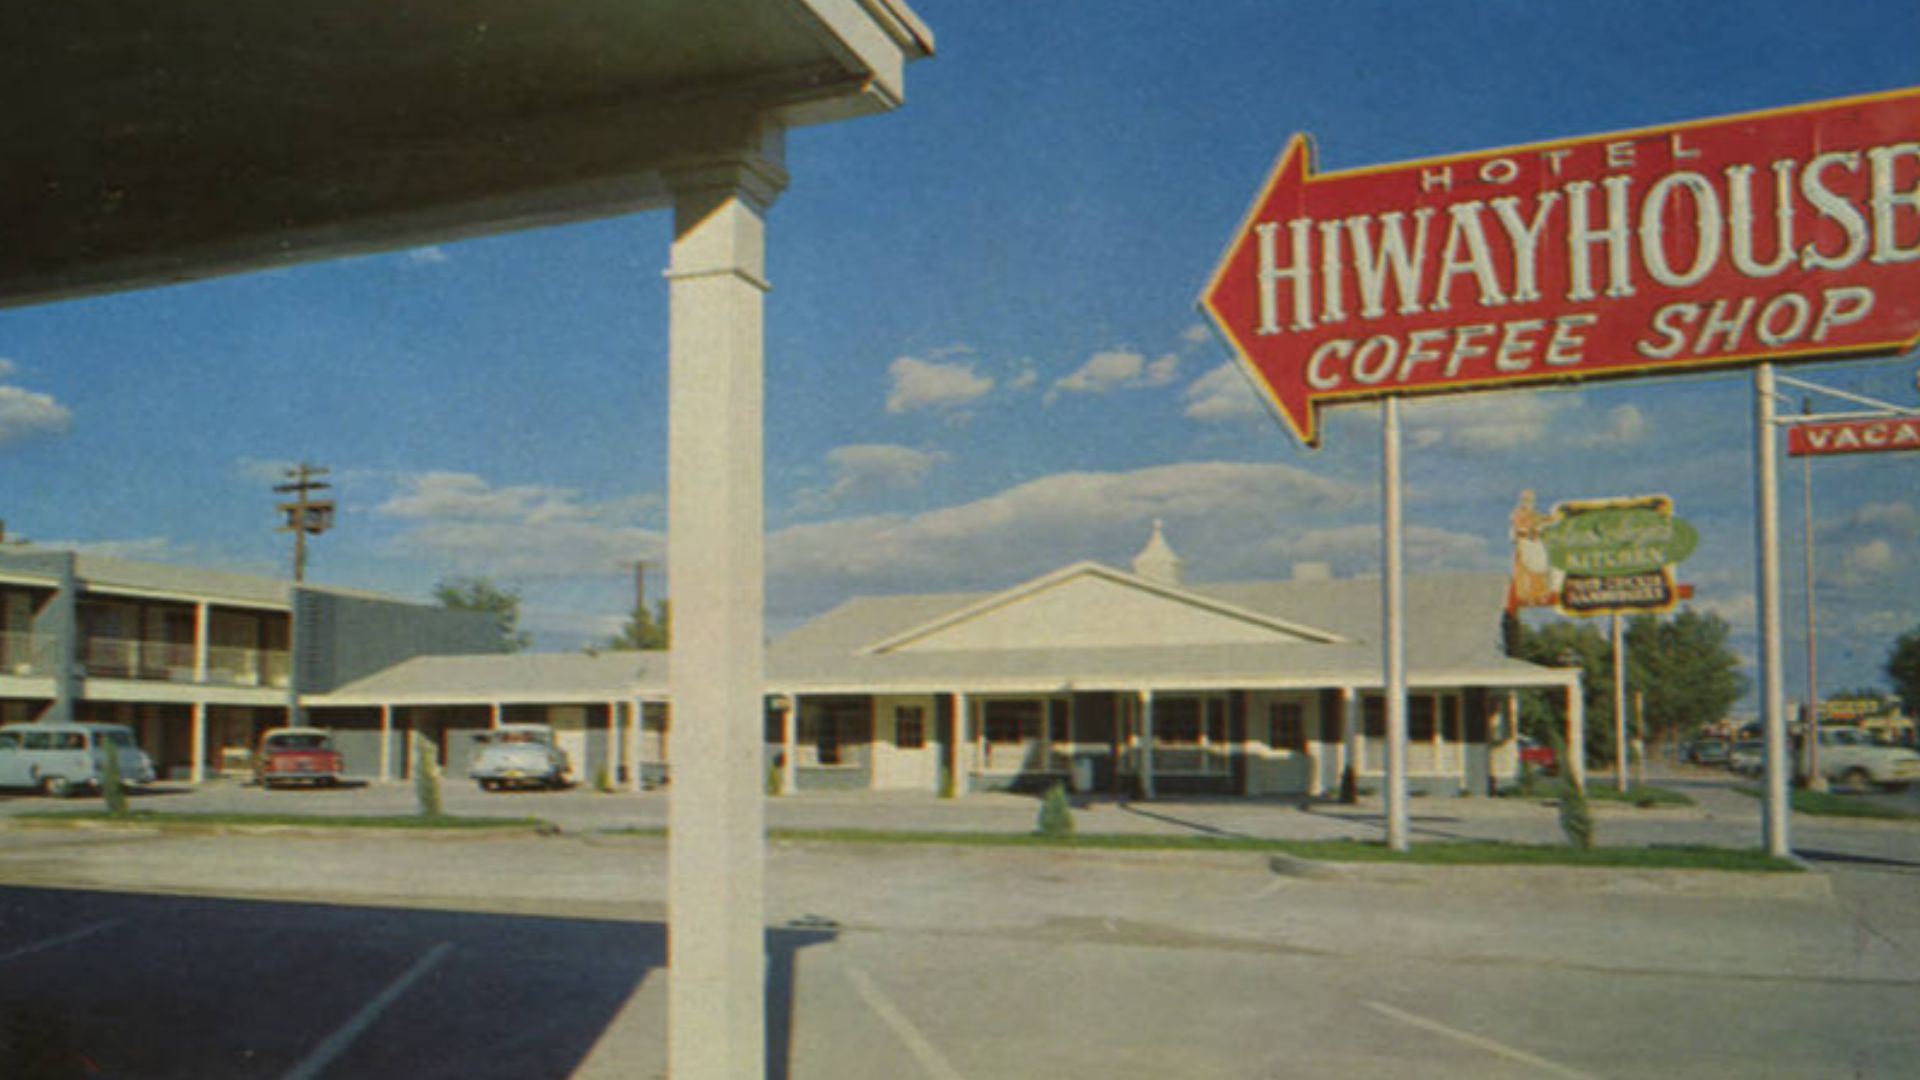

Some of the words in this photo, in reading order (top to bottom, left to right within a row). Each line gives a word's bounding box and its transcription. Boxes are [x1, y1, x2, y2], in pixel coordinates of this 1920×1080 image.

[1421, 134, 1701, 192] HOTEL
[1255, 142, 1920, 335] HIWAYHOUSE
[1307, 315, 1598, 388] COFFEE
[1637, 286, 1875, 358] SHOP
[1566, 546, 1664, 570] KITCHEN
